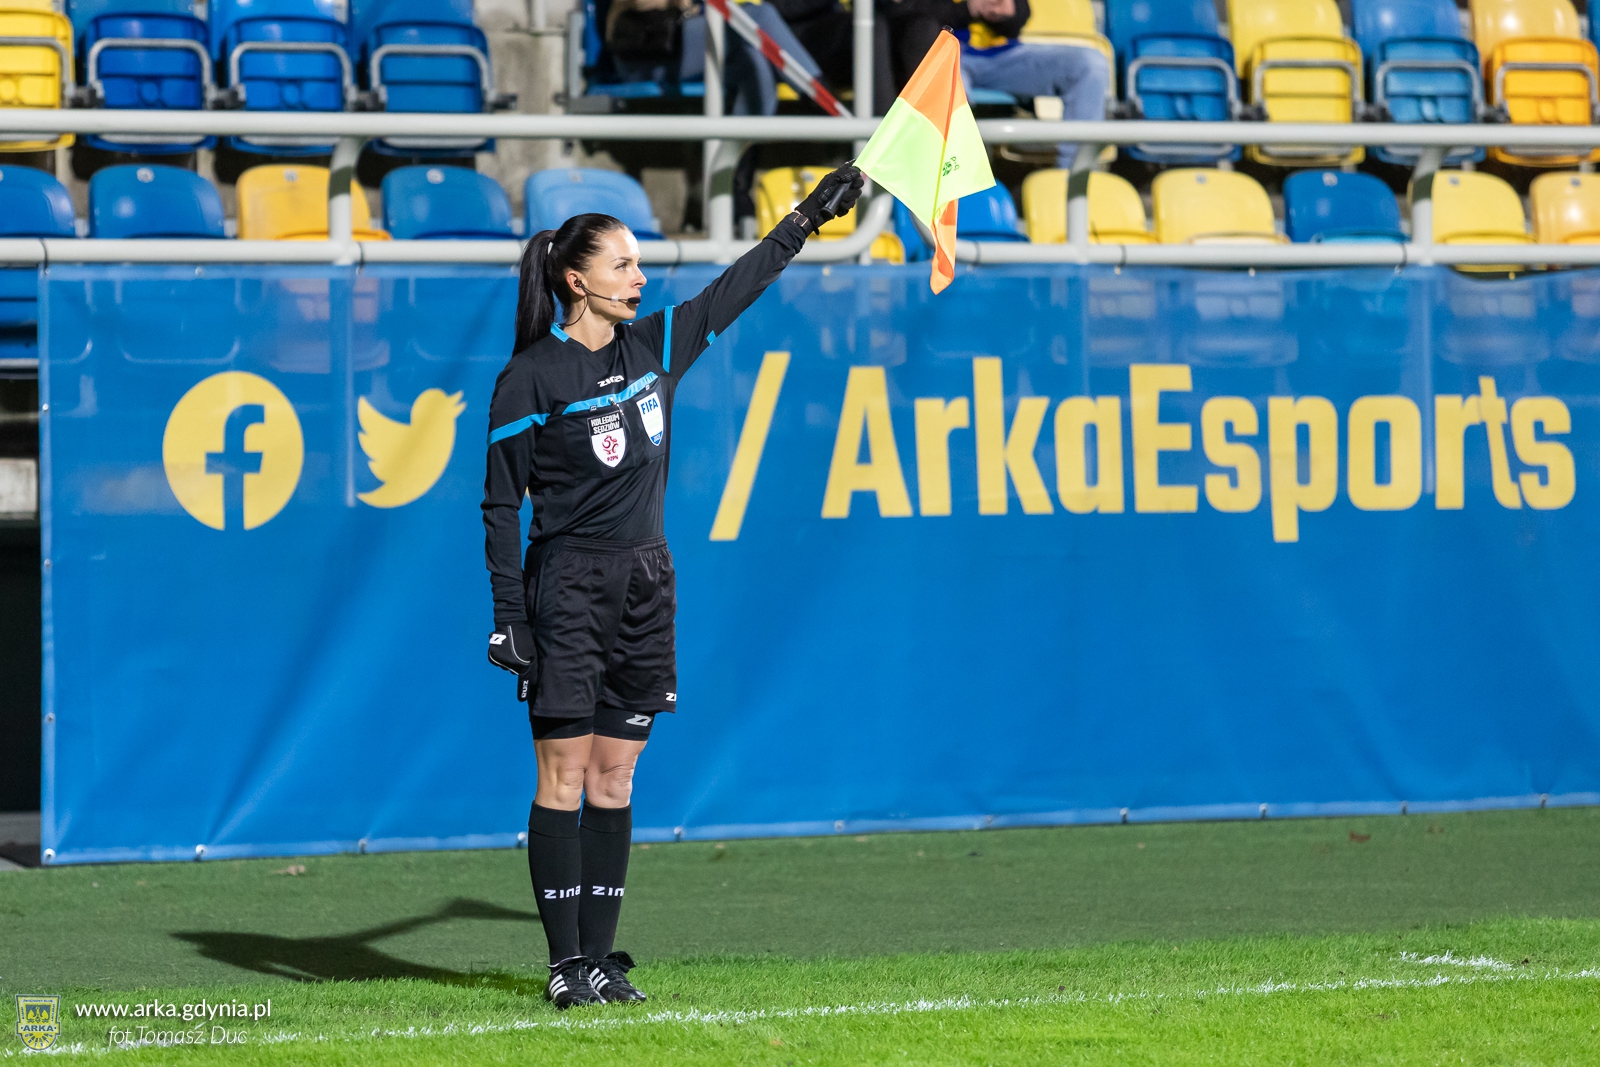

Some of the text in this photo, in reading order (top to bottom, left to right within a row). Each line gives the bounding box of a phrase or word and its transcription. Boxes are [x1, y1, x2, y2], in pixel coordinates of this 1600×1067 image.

[640, 398, 659, 415] FIFA
[590, 413, 620, 427] KOLEGIUM
[821, 356, 1576, 542] ArkaEsports
